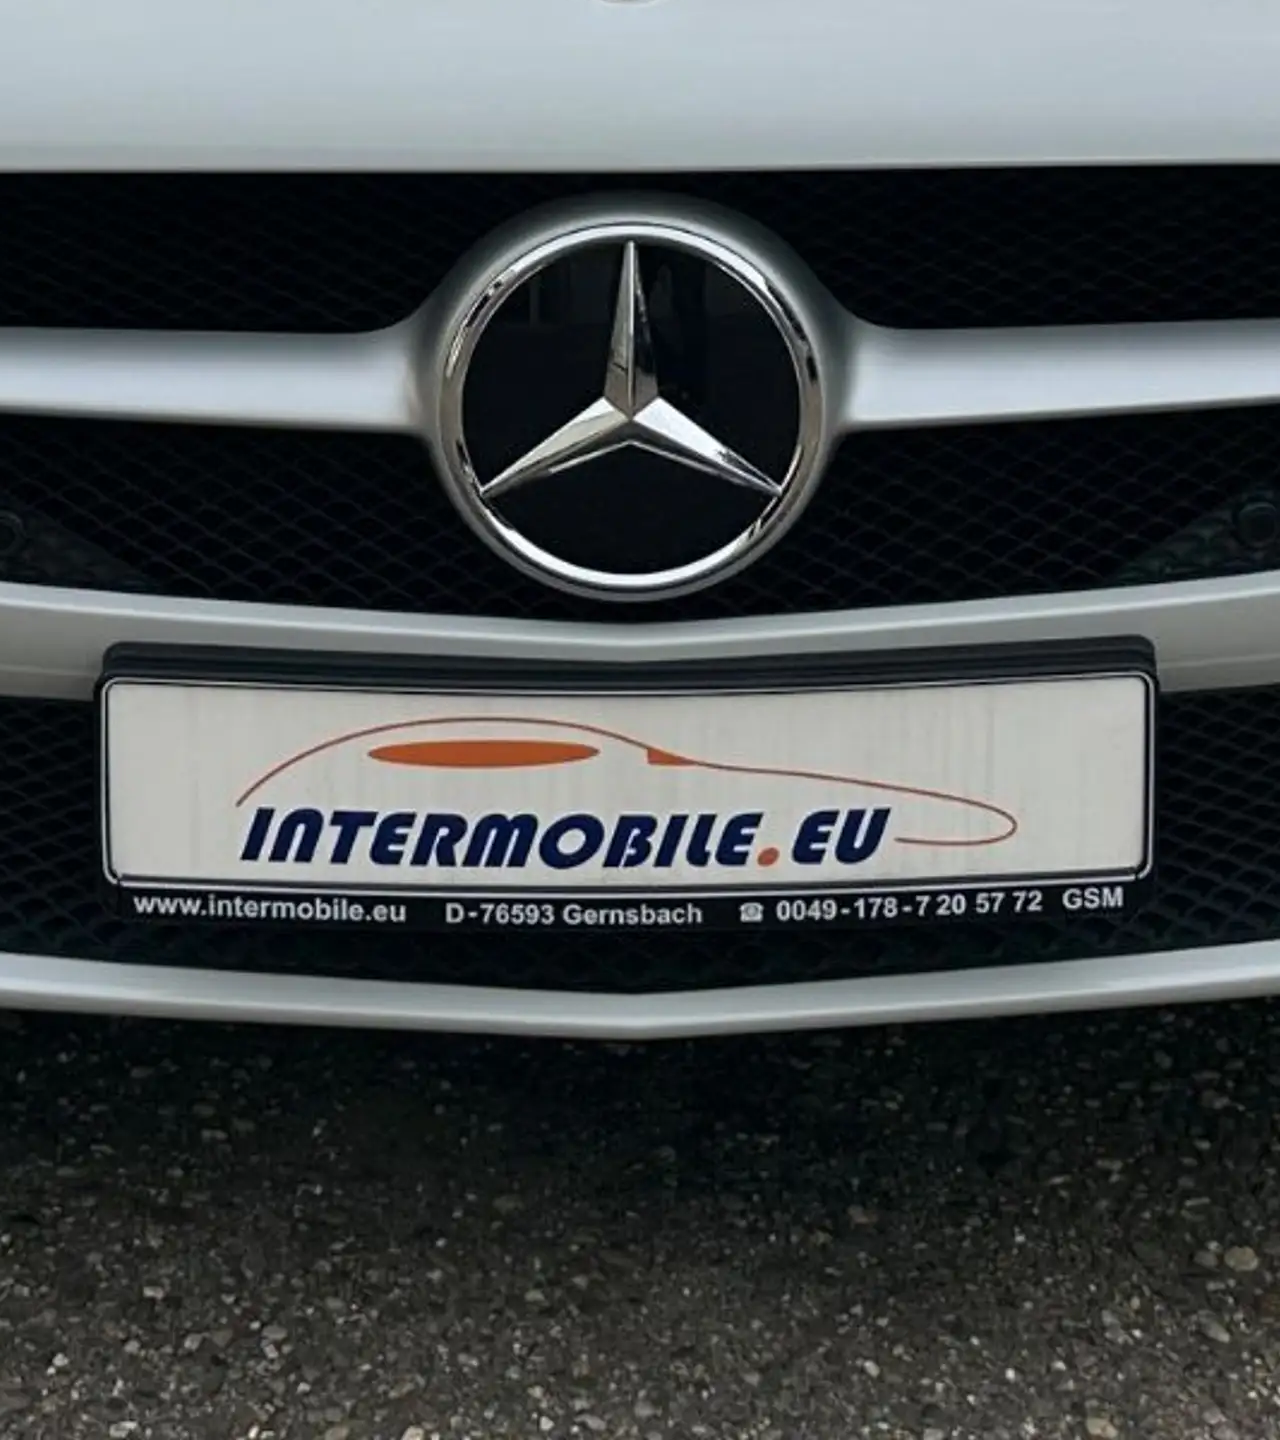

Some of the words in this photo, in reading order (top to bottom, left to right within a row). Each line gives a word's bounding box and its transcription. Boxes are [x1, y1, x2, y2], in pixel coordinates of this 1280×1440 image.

[241, 806, 890, 869] INTERMOBILE.EU
[133, 894, 406, 922] www.intermobile.eu
[445, 903, 555, 925] D-76593
[563, 902, 703, 925] Gernsbach
[1062, 887, 1125, 909] GSM
